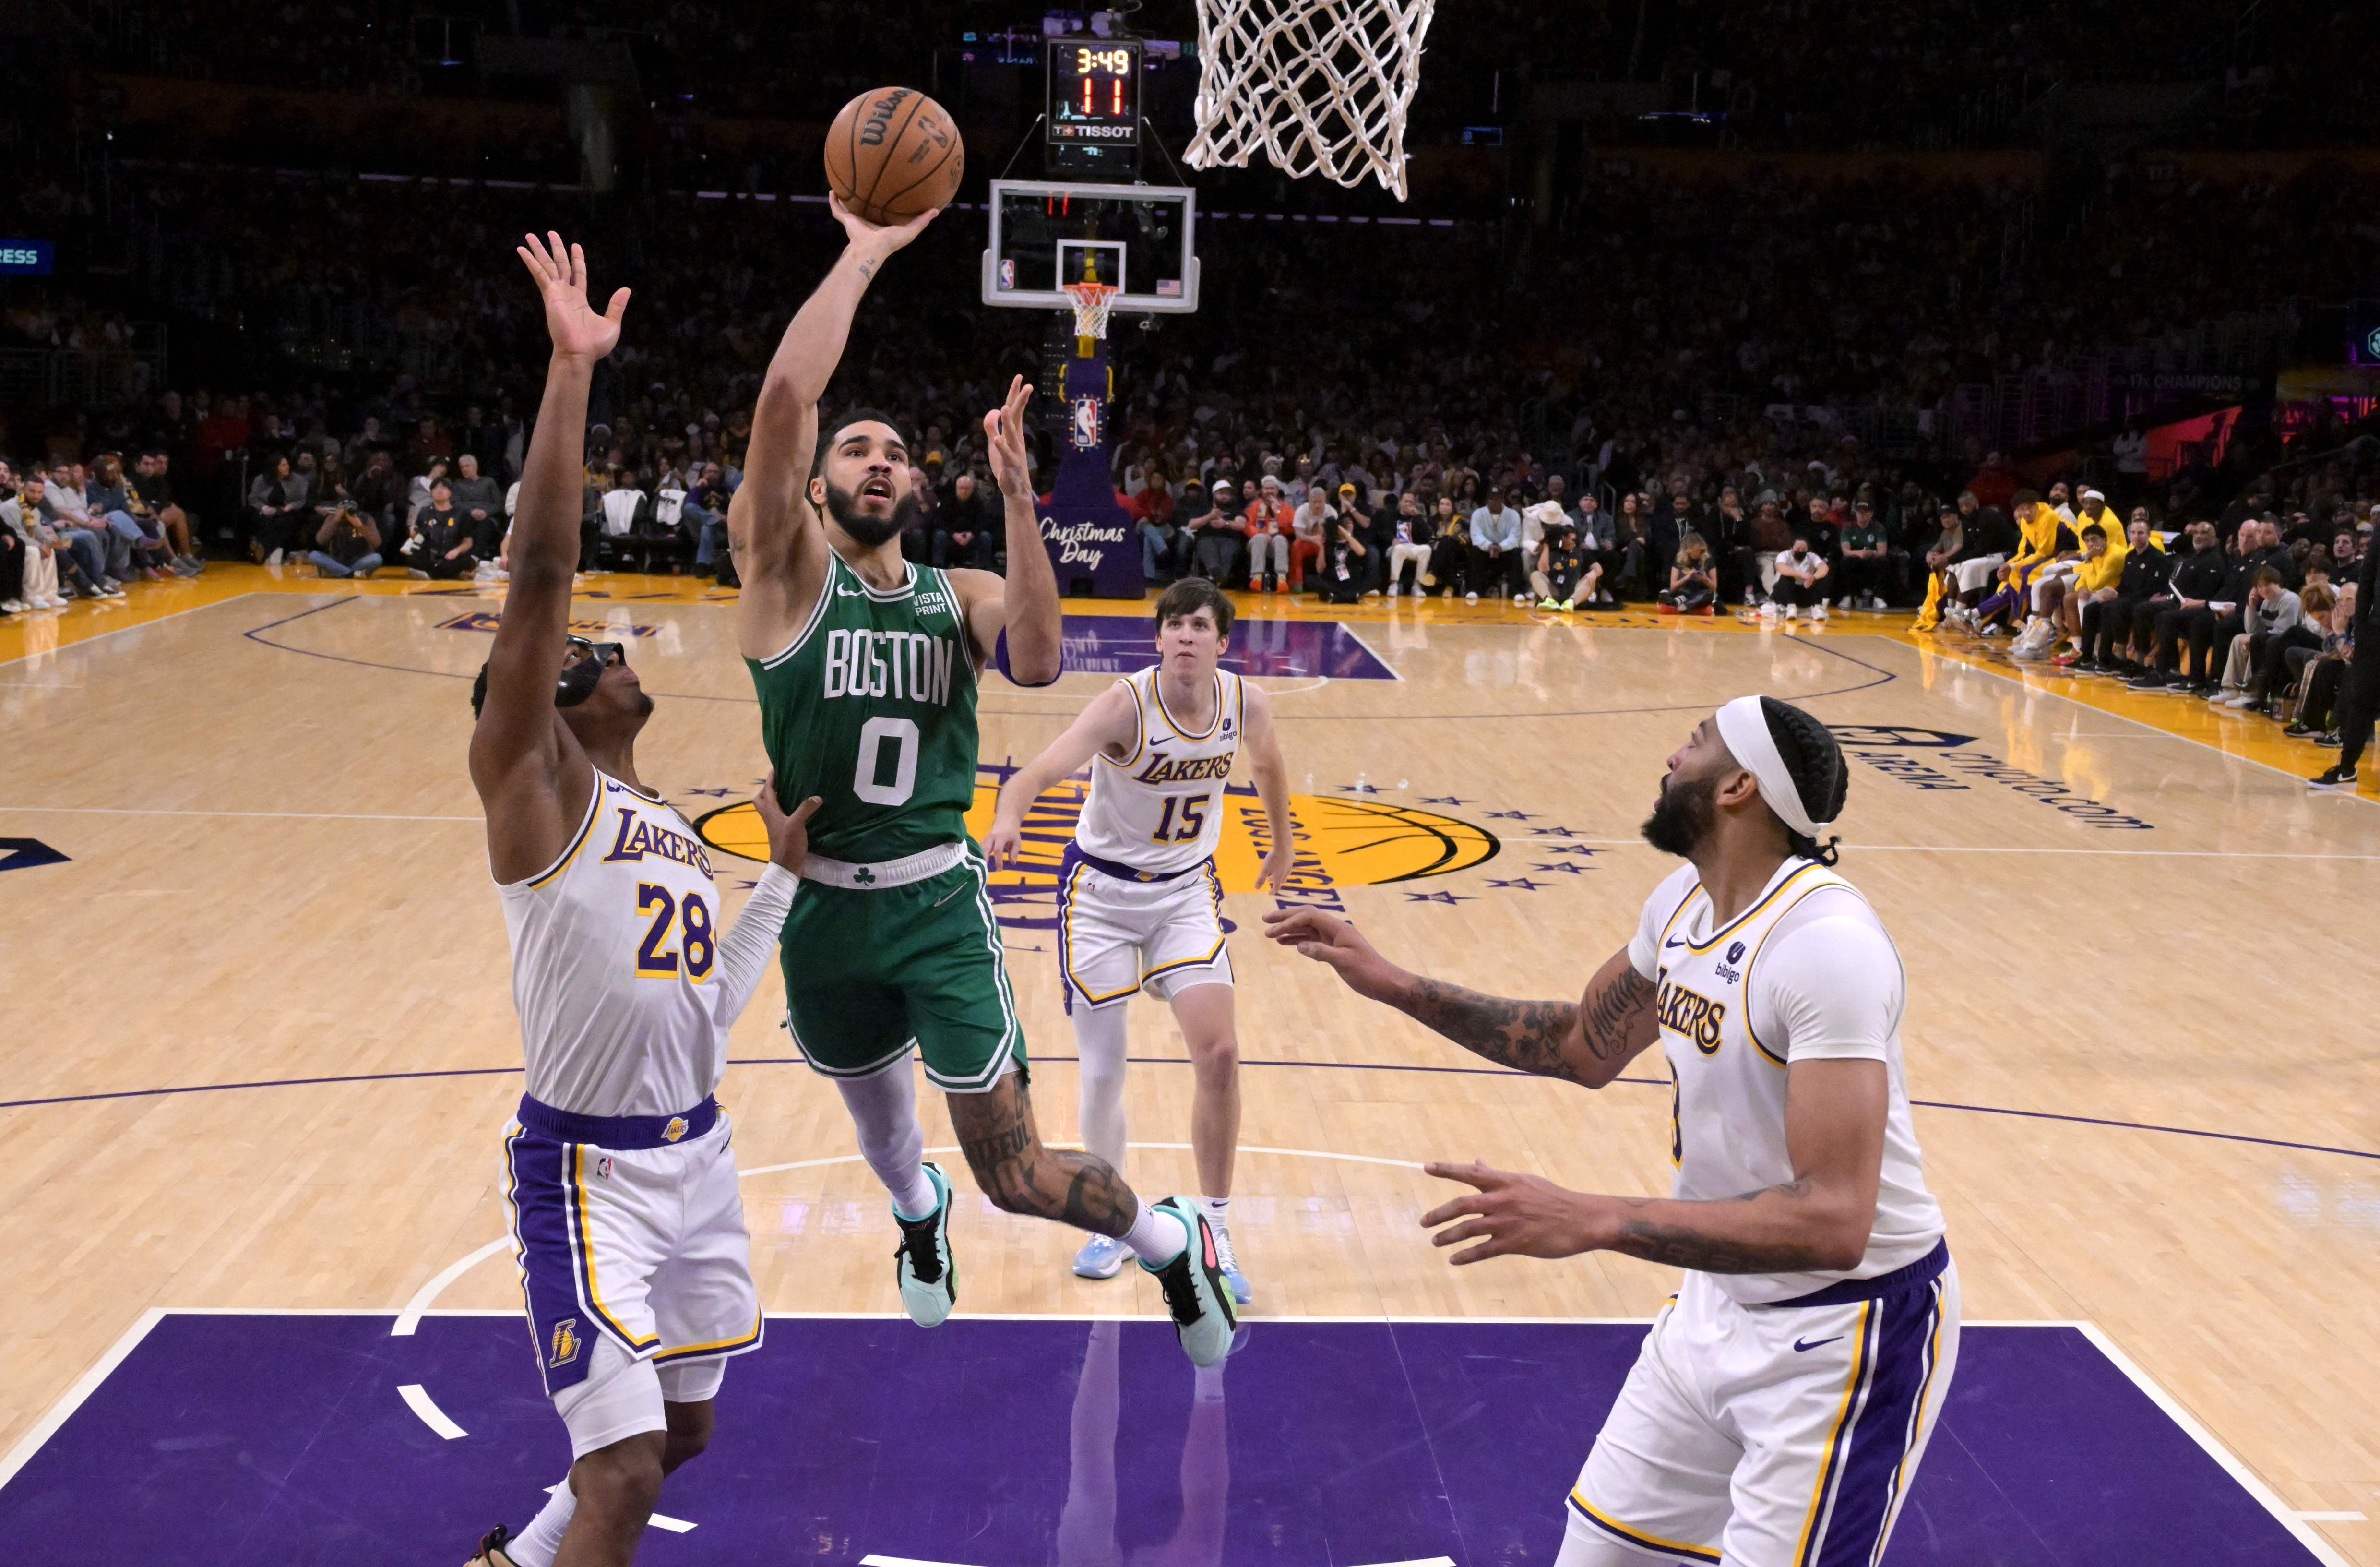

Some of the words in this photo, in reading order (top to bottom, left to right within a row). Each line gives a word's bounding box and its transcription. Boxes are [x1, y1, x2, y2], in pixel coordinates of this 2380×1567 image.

[1077, 48, 1129, 75] 3:49
[1084, 77, 1122, 116] 11
[1075, 125, 1134, 138] TISSOT
[1039, 517, 1126, 543] Christmas
[1060, 539, 1104, 571] Day
[914, 592, 945, 607] VISTA
[915, 603, 946, 616] PRINT
[824, 628, 954, 707] BOSTON
[853, 716, 920, 806] 0
[1132, 752, 1235, 786] LAKERS
[1844, 751, 1972, 789] ARENA
[1938, 753, 2155, 829] crypto.com
[1151, 793, 1211, 845] 15
[601, 806, 714, 881] LAKERS
[635, 880, 714, 984] 28
[1715, 962, 1740, 985] bibigo
